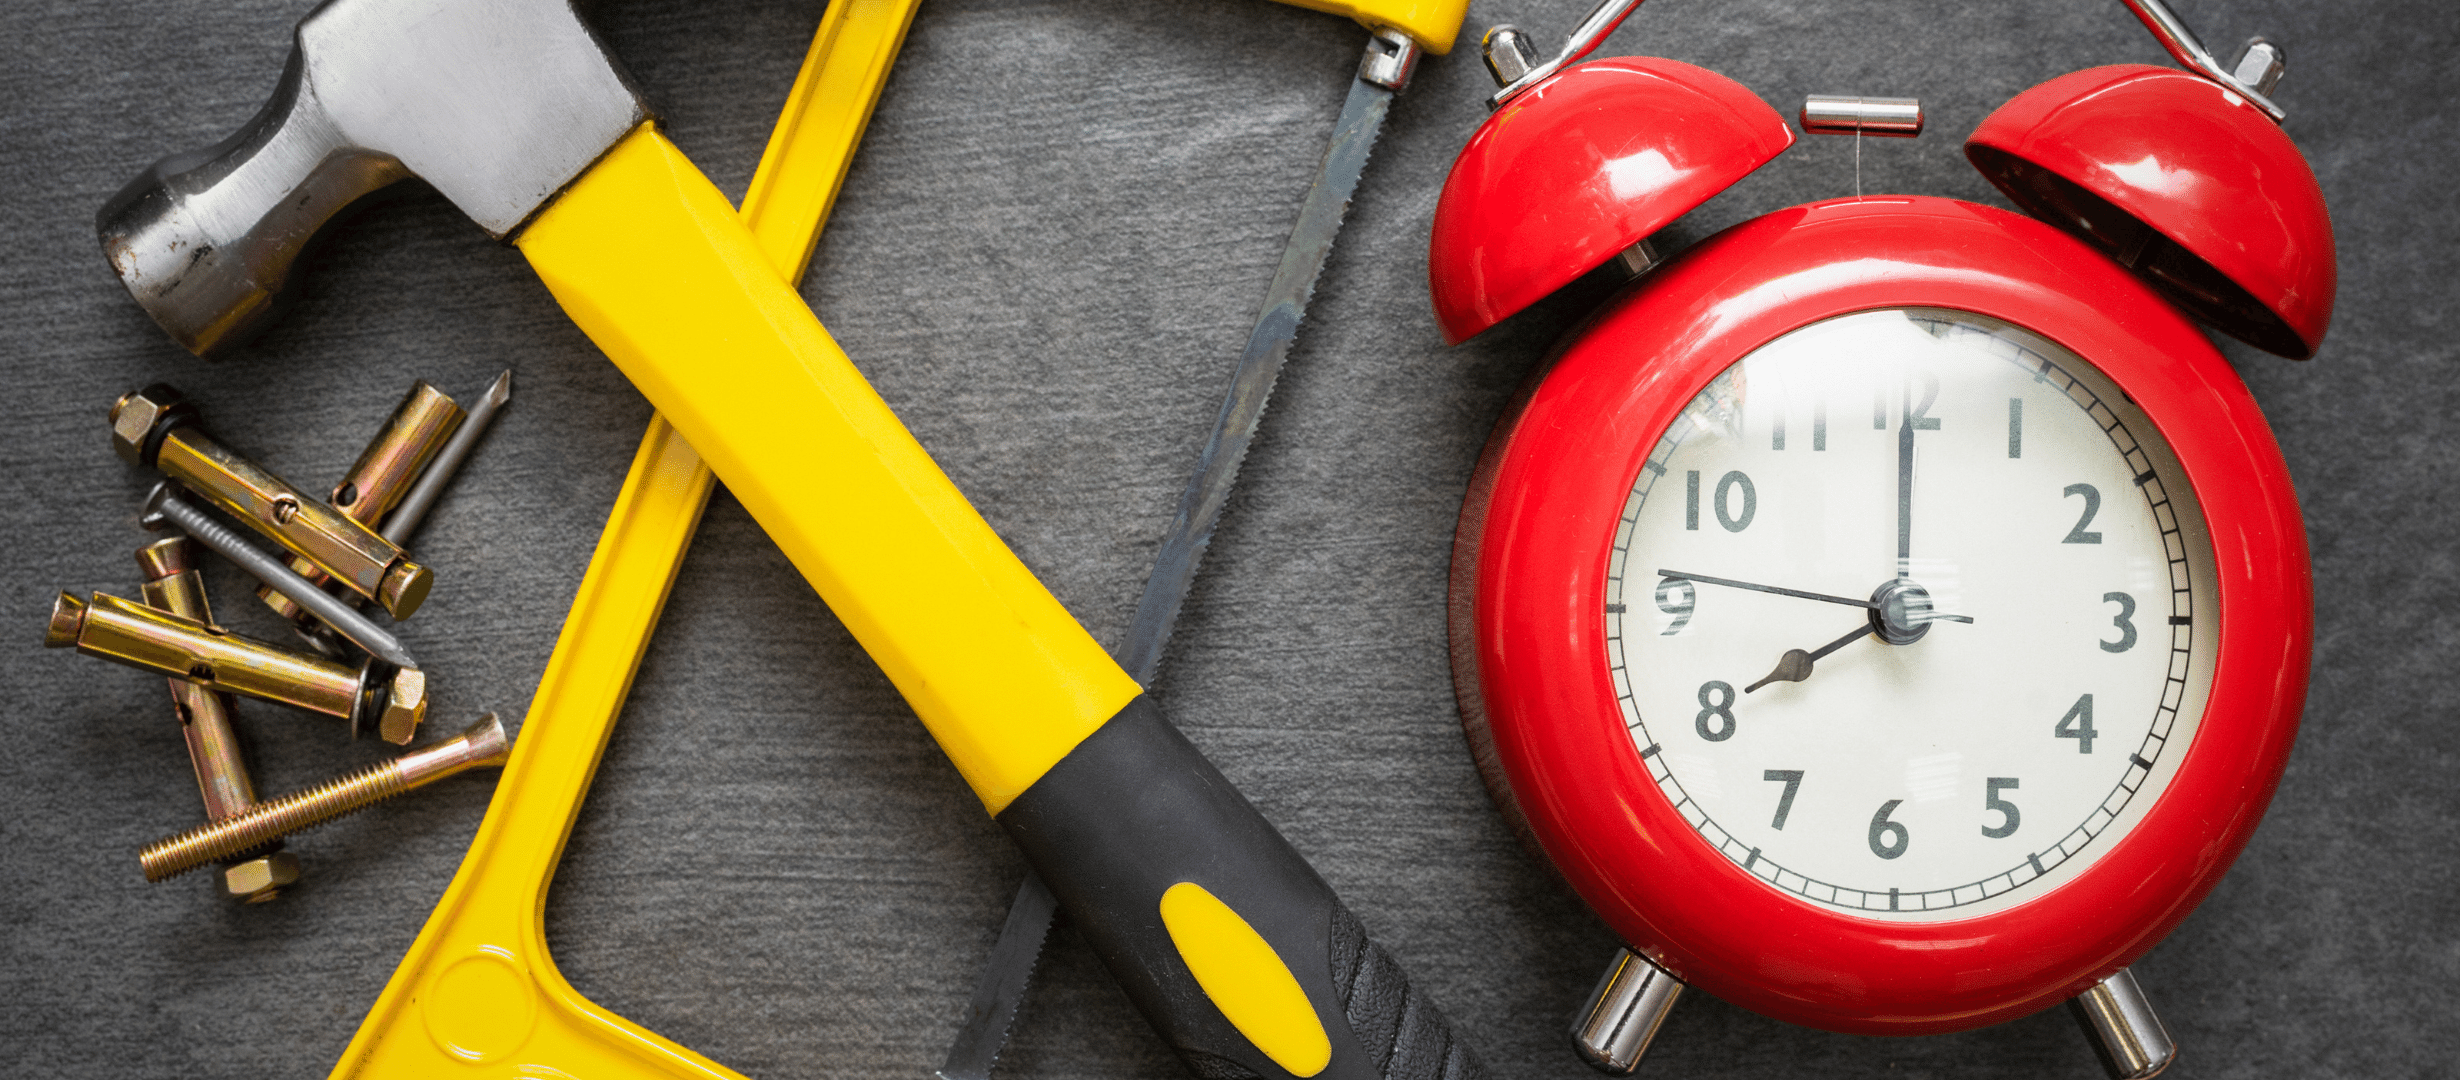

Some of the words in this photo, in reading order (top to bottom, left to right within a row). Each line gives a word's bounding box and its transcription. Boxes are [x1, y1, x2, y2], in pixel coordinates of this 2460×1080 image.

[1772, 403, 1826, 452] 11
[1873, 374, 1941, 430] 12
[2008, 397, 2023, 459] 1
[1685, 470, 1757, 533] 10
[2061, 483, 2103, 544] 2
[1654, 576, 1696, 636] 9
[2099, 592, 2138, 653] 3
[1695, 680, 1737, 742] 8
[2054, 693, 2098, 754] 4
[1763, 769, 1805, 831] 7
[1867, 800, 1910, 860] 6
[1981, 777, 2021, 839] 5
